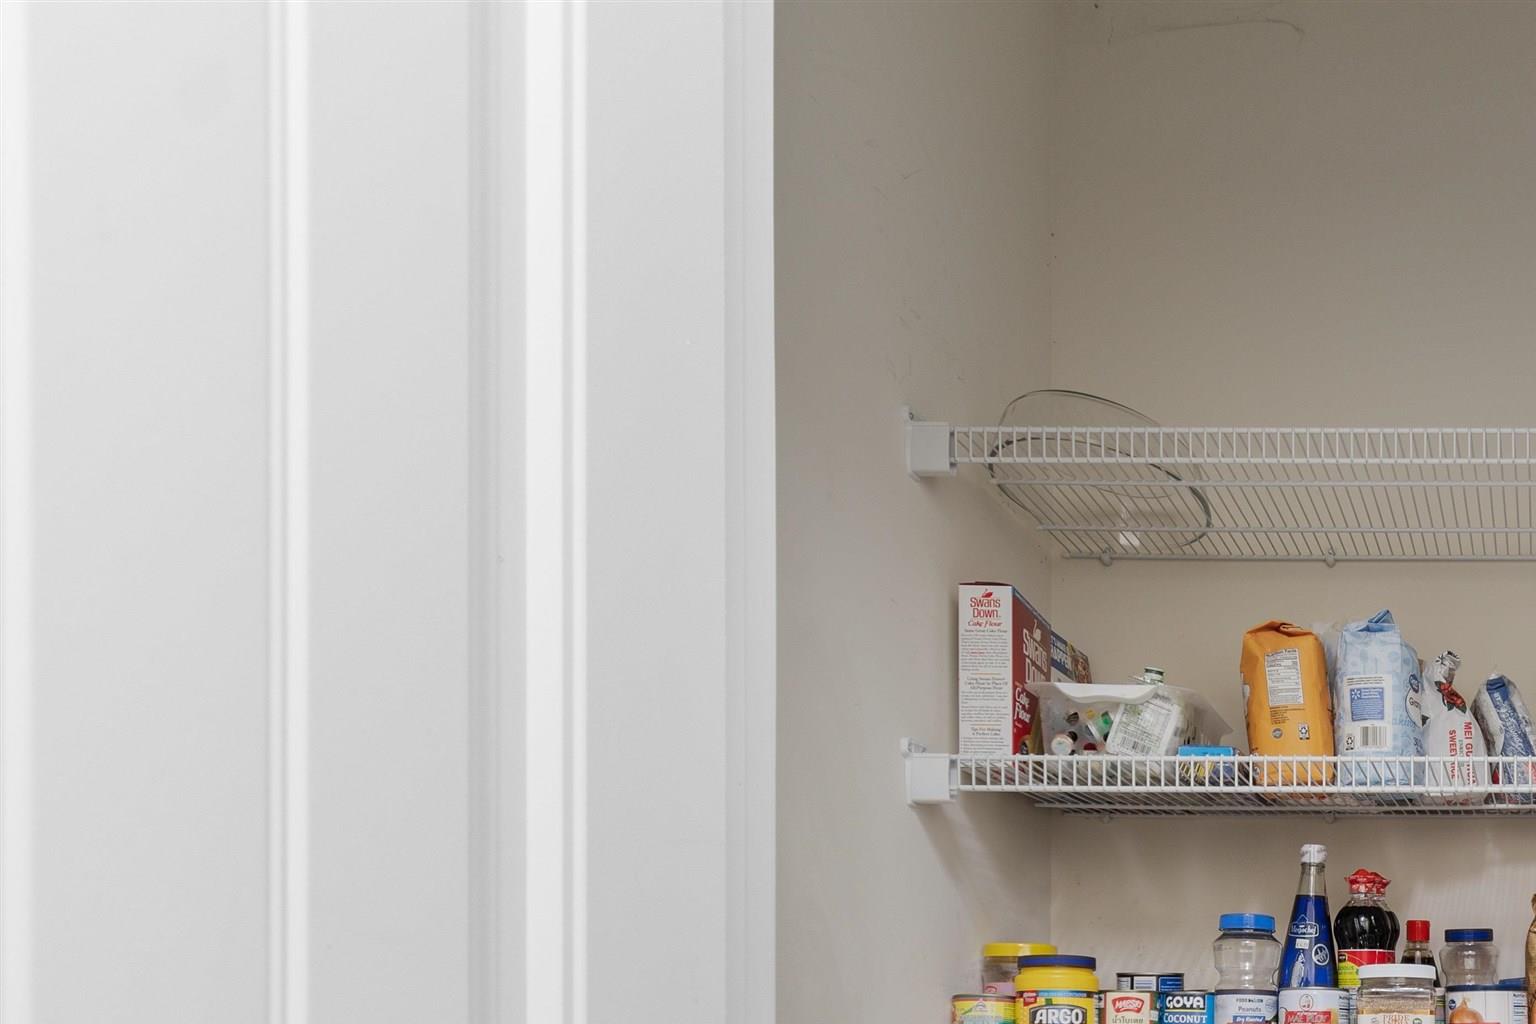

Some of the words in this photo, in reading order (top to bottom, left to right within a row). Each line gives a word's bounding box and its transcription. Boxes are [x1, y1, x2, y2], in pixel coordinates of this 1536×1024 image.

[969, 596, 1001, 608] Swans
[972, 607, 999, 618] Down
[1022, 627, 1048, 673] Swans
[1464, 721, 1473, 740] MEI
[1165, 995, 1205, 1009] GOYA
[1034, 1008, 1083, 1024] ARGO
[1163, 1013, 1208, 1024] COCONUT
